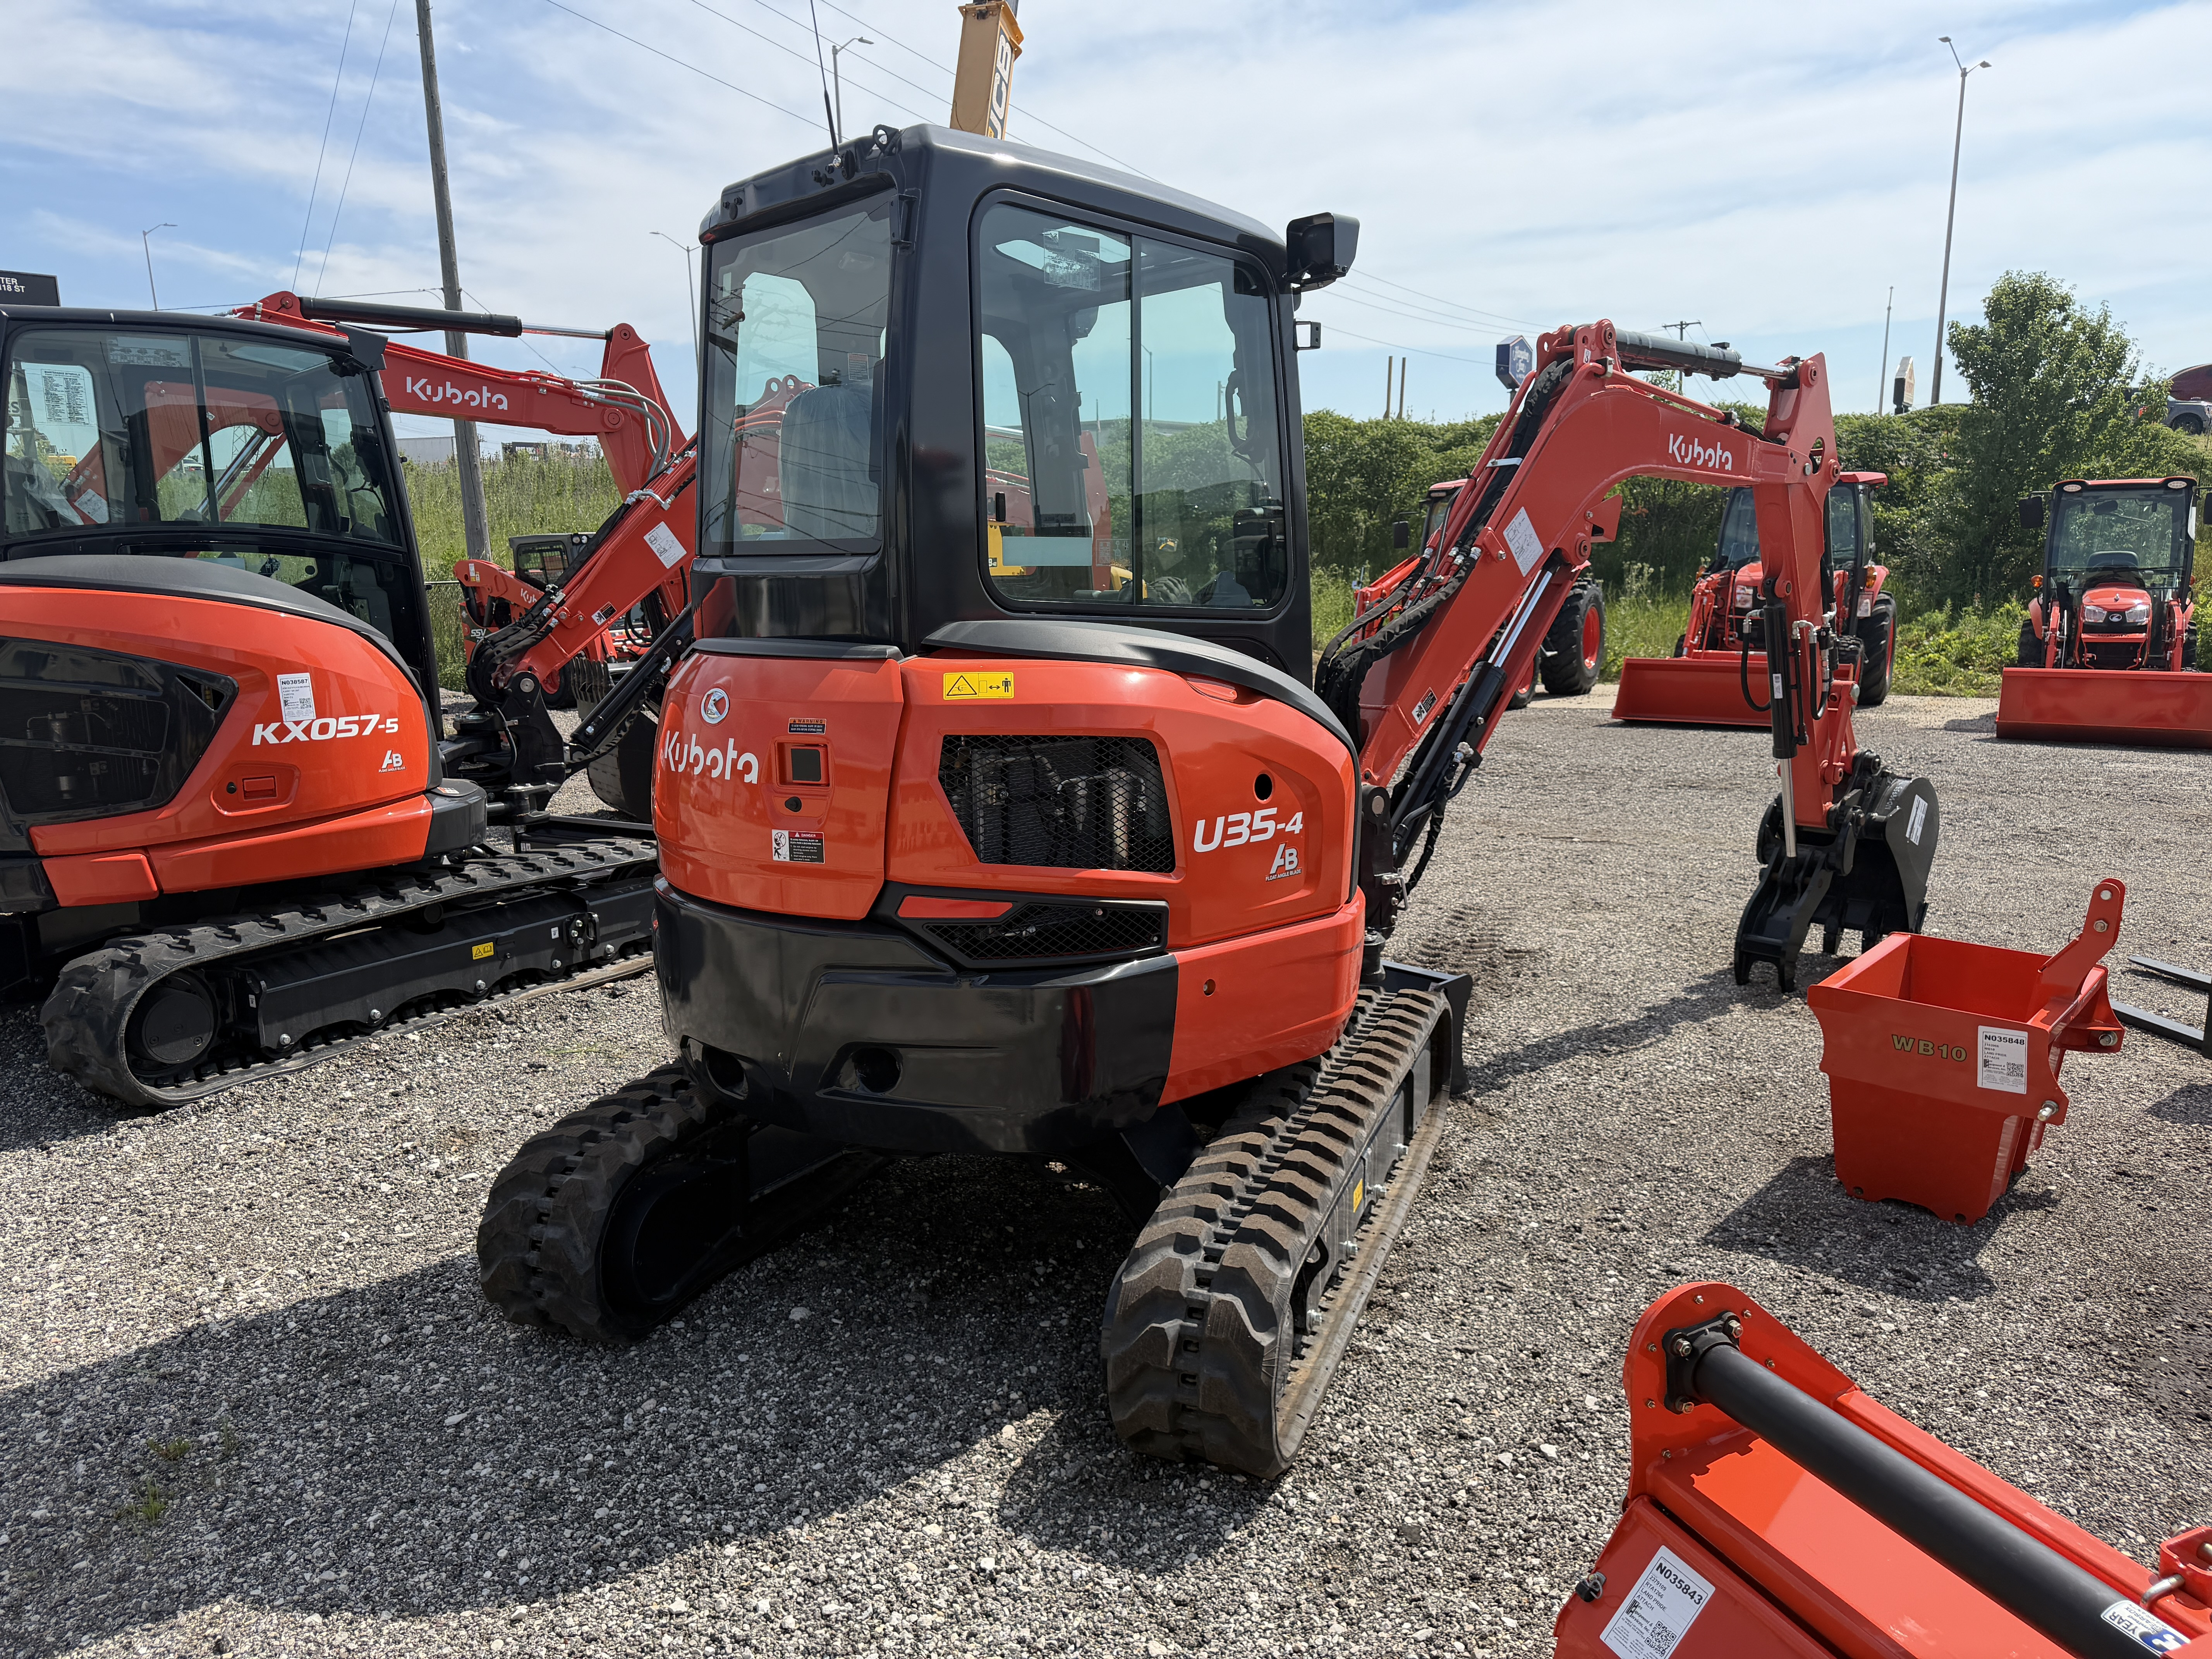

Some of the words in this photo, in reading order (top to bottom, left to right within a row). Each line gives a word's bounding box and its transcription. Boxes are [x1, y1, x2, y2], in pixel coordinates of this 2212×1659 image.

[406, 376, 508, 410] Kubota
[1668, 433, 1732, 471] Kubota
[520, 588, 537, 604] Kub
[471, 628, 486, 637] SSV
[252, 714, 398, 745] KX057-5
[664, 730, 759, 784] Kubota
[1194, 807, 1303, 852] U35-4
[1891, 1034, 1967, 1062] WB10
[1984, 1034, 2025, 1045] N035848
[1645, 1581, 1664, 1599] RTA1266
[1649, 1575, 1667, 1591] 2379109
[1656, 1562, 1703, 1605] N035843
[1636, 1594, 1654, 1611] ATTACH
[1640, 1588, 1653, 1600] LAND
[1653, 1598, 1667, 1612] PRIDE
[2109, 1611, 2138, 1635] YEAR
